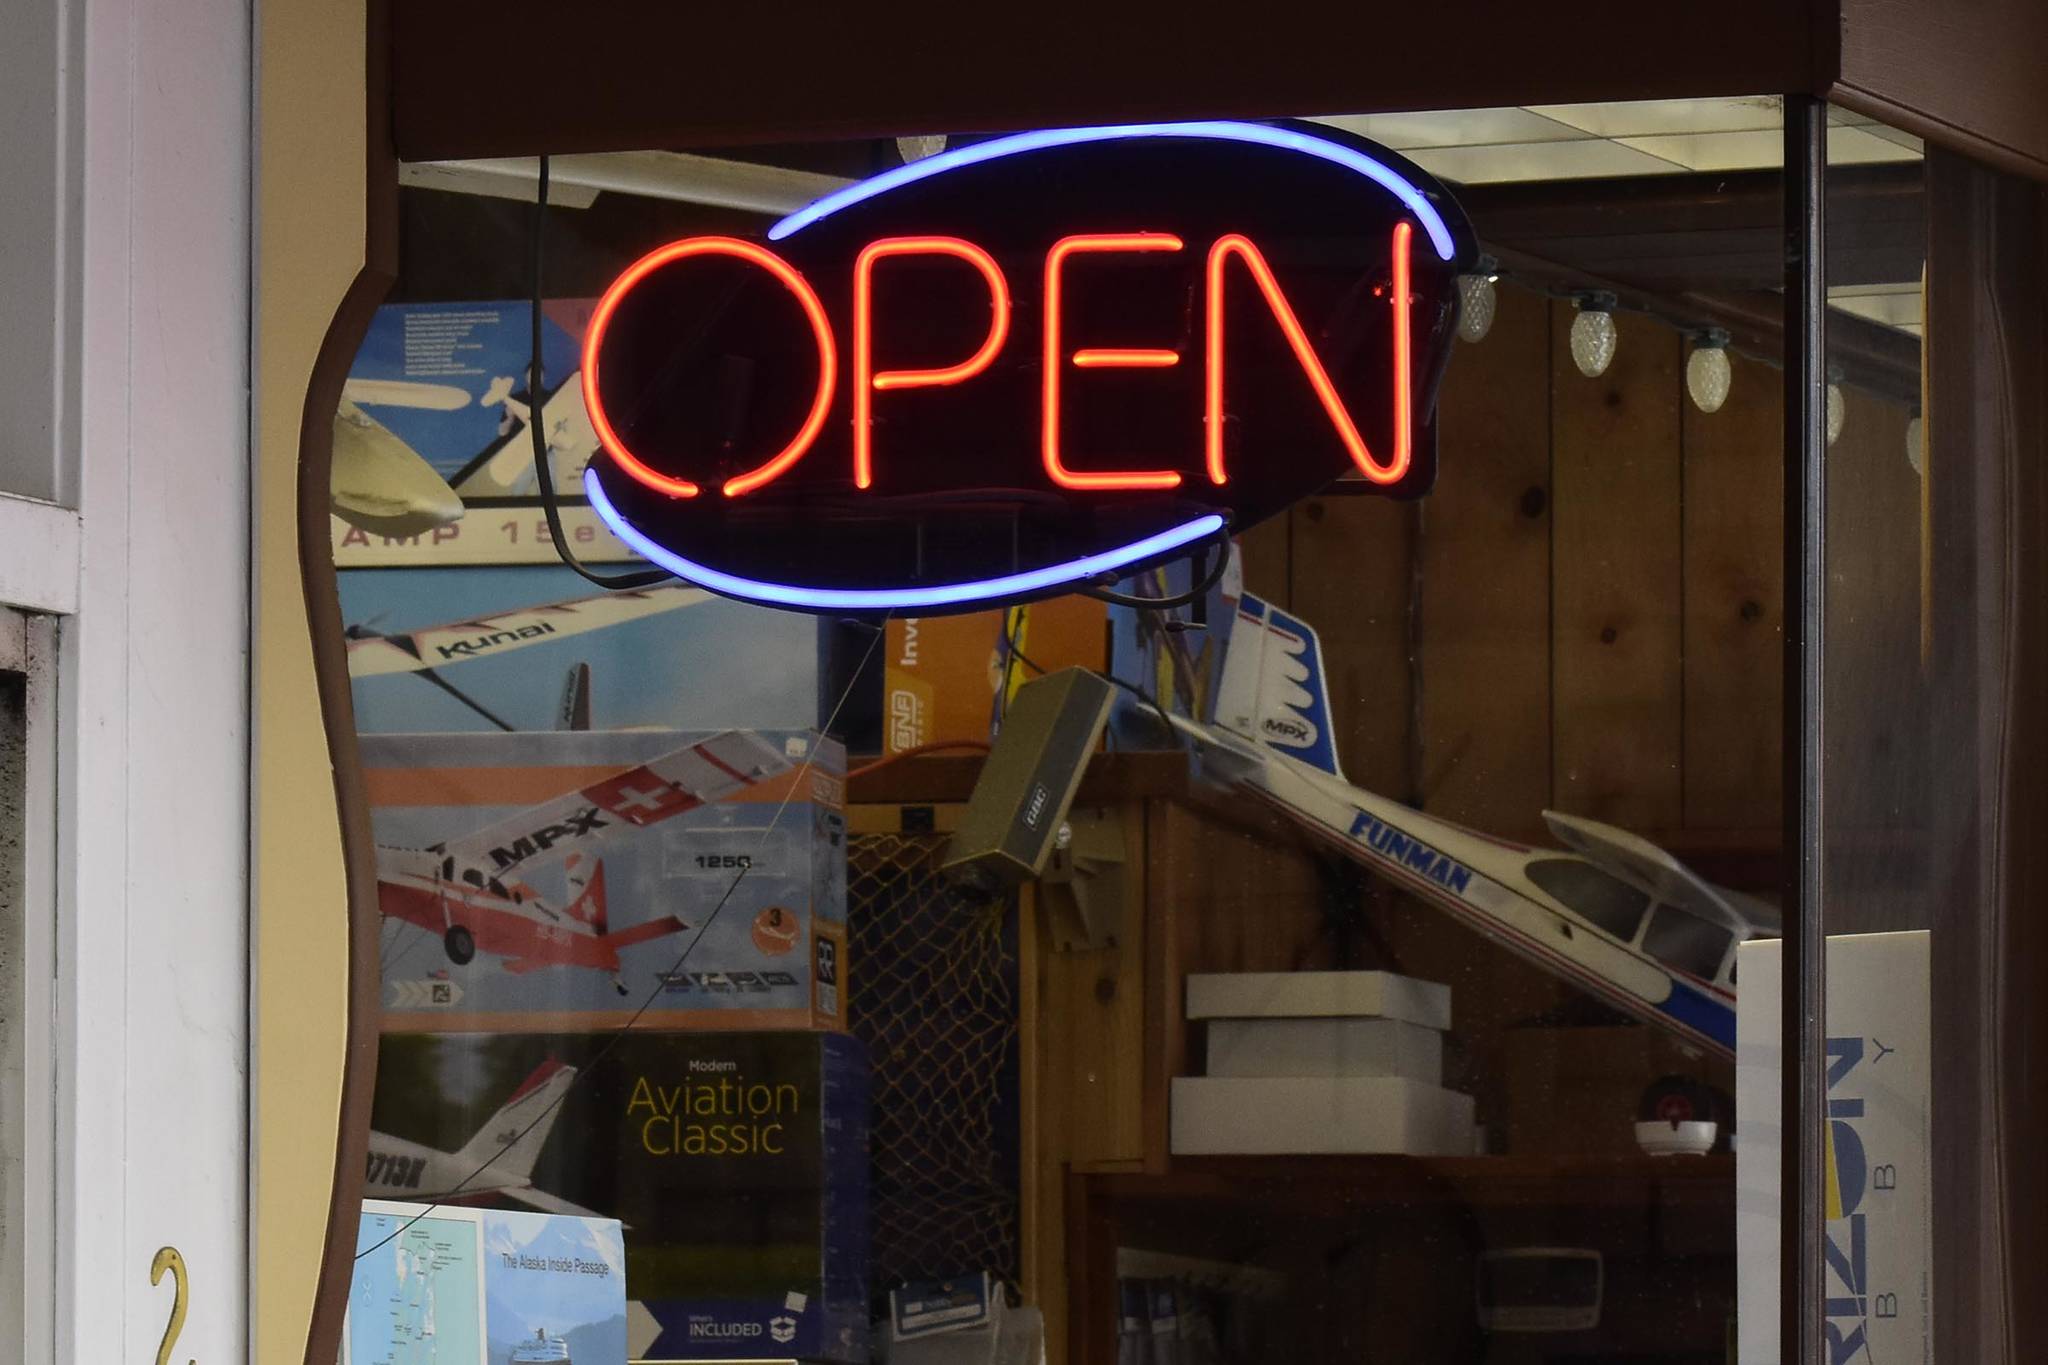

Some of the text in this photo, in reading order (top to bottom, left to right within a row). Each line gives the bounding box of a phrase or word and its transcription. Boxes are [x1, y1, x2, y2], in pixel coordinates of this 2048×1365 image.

[582, 220, 1413, 498] OPEN
[1265, 718, 1308, 741] MPX
[489, 807, 609, 869] MPX
[695, 855, 752, 869] 1250
[1349, 812, 1473, 893] FUNMAN
[770, 908, 781, 927] 3
[689, 1060, 737, 1072] Modern
[627, 1075, 799, 1115] Aviation
[642, 1115, 785, 1155] Classic
[502, 1252, 610, 1279] The Alaska Inside Passage
[690, 1323, 763, 1337] INCLUDED
